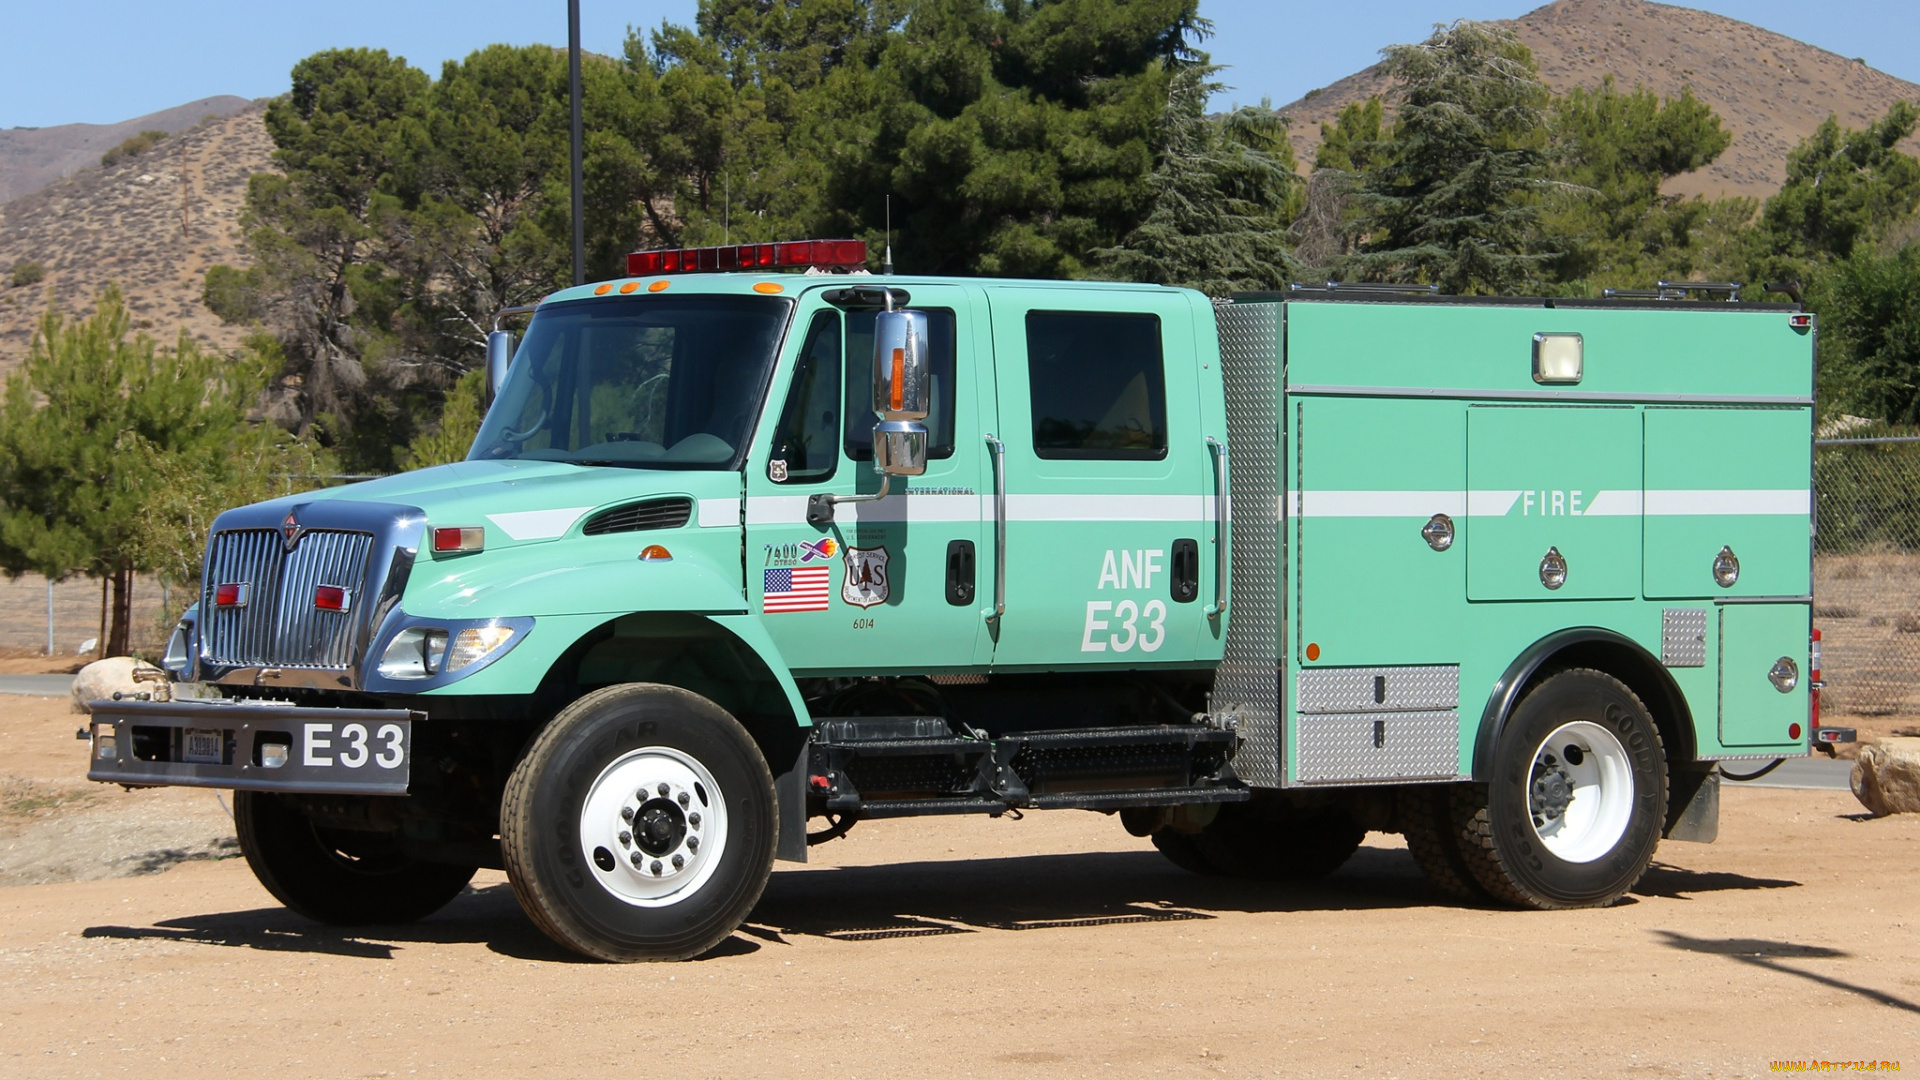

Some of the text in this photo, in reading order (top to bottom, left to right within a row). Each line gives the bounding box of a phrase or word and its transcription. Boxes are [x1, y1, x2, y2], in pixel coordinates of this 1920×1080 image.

[905, 486, 975, 496] INTERNATIONAL
[1523, 490, 1582, 516] FIRE
[764, 543, 797, 566] 7400
[866, 552, 885, 562] SERVICE
[1097, 549, 1163, 590] ANF
[853, 618, 874, 629] 6014
[1081, 599, 1167, 653] E33
[303, 723, 405, 769] E33
